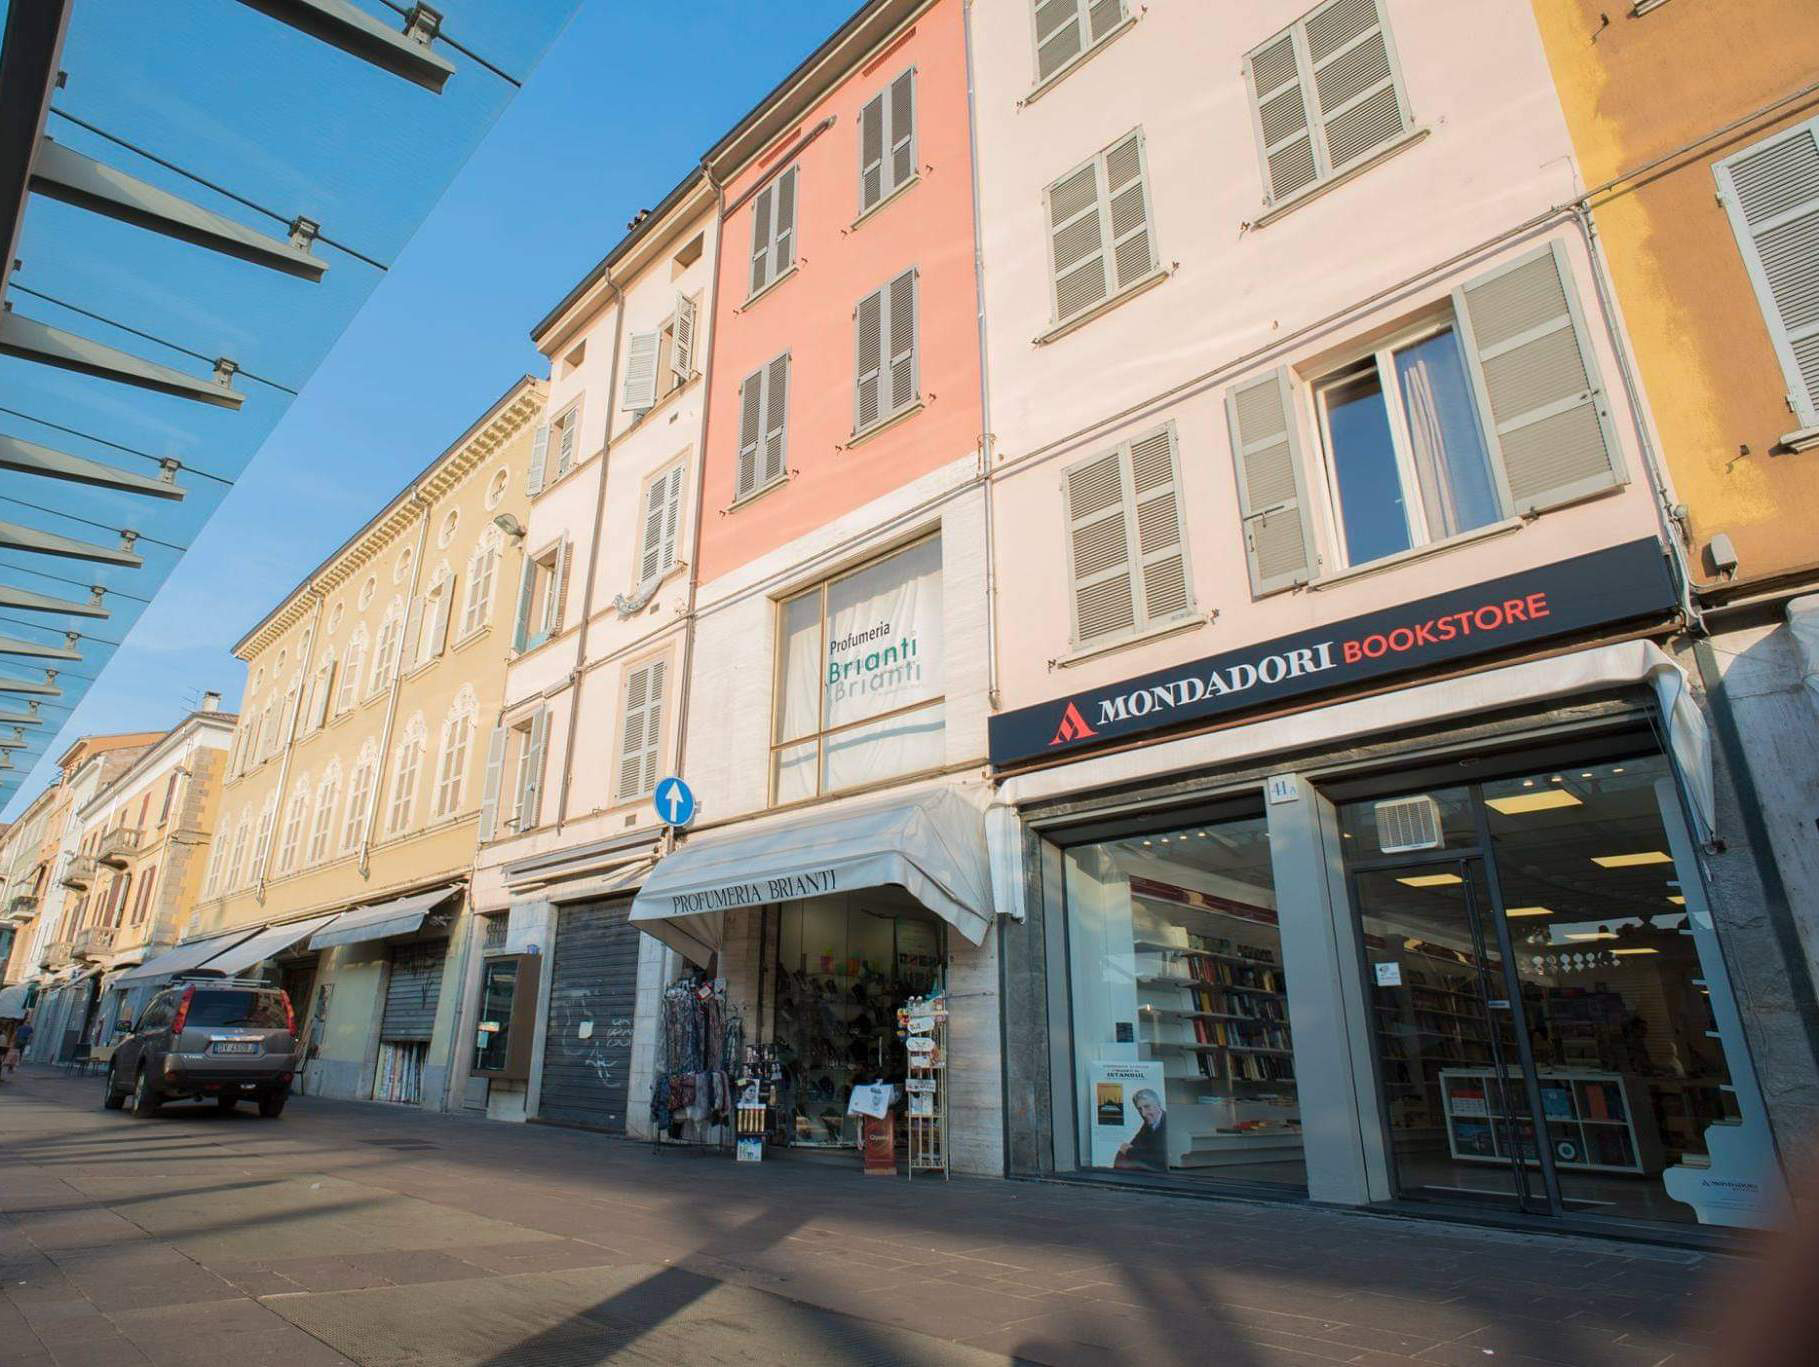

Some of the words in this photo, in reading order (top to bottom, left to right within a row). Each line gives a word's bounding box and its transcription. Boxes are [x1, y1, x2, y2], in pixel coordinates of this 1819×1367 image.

[829, 631, 917, 684] Brianti
[830, 621, 890, 655] Profumeria
[1097, 641, 1337, 726] MONDADORI
[1343, 592, 1550, 664] BOOKSTORE
[672, 884, 761, 913] PROFUMERIA
[767, 869, 837, 900] BRIANTI
